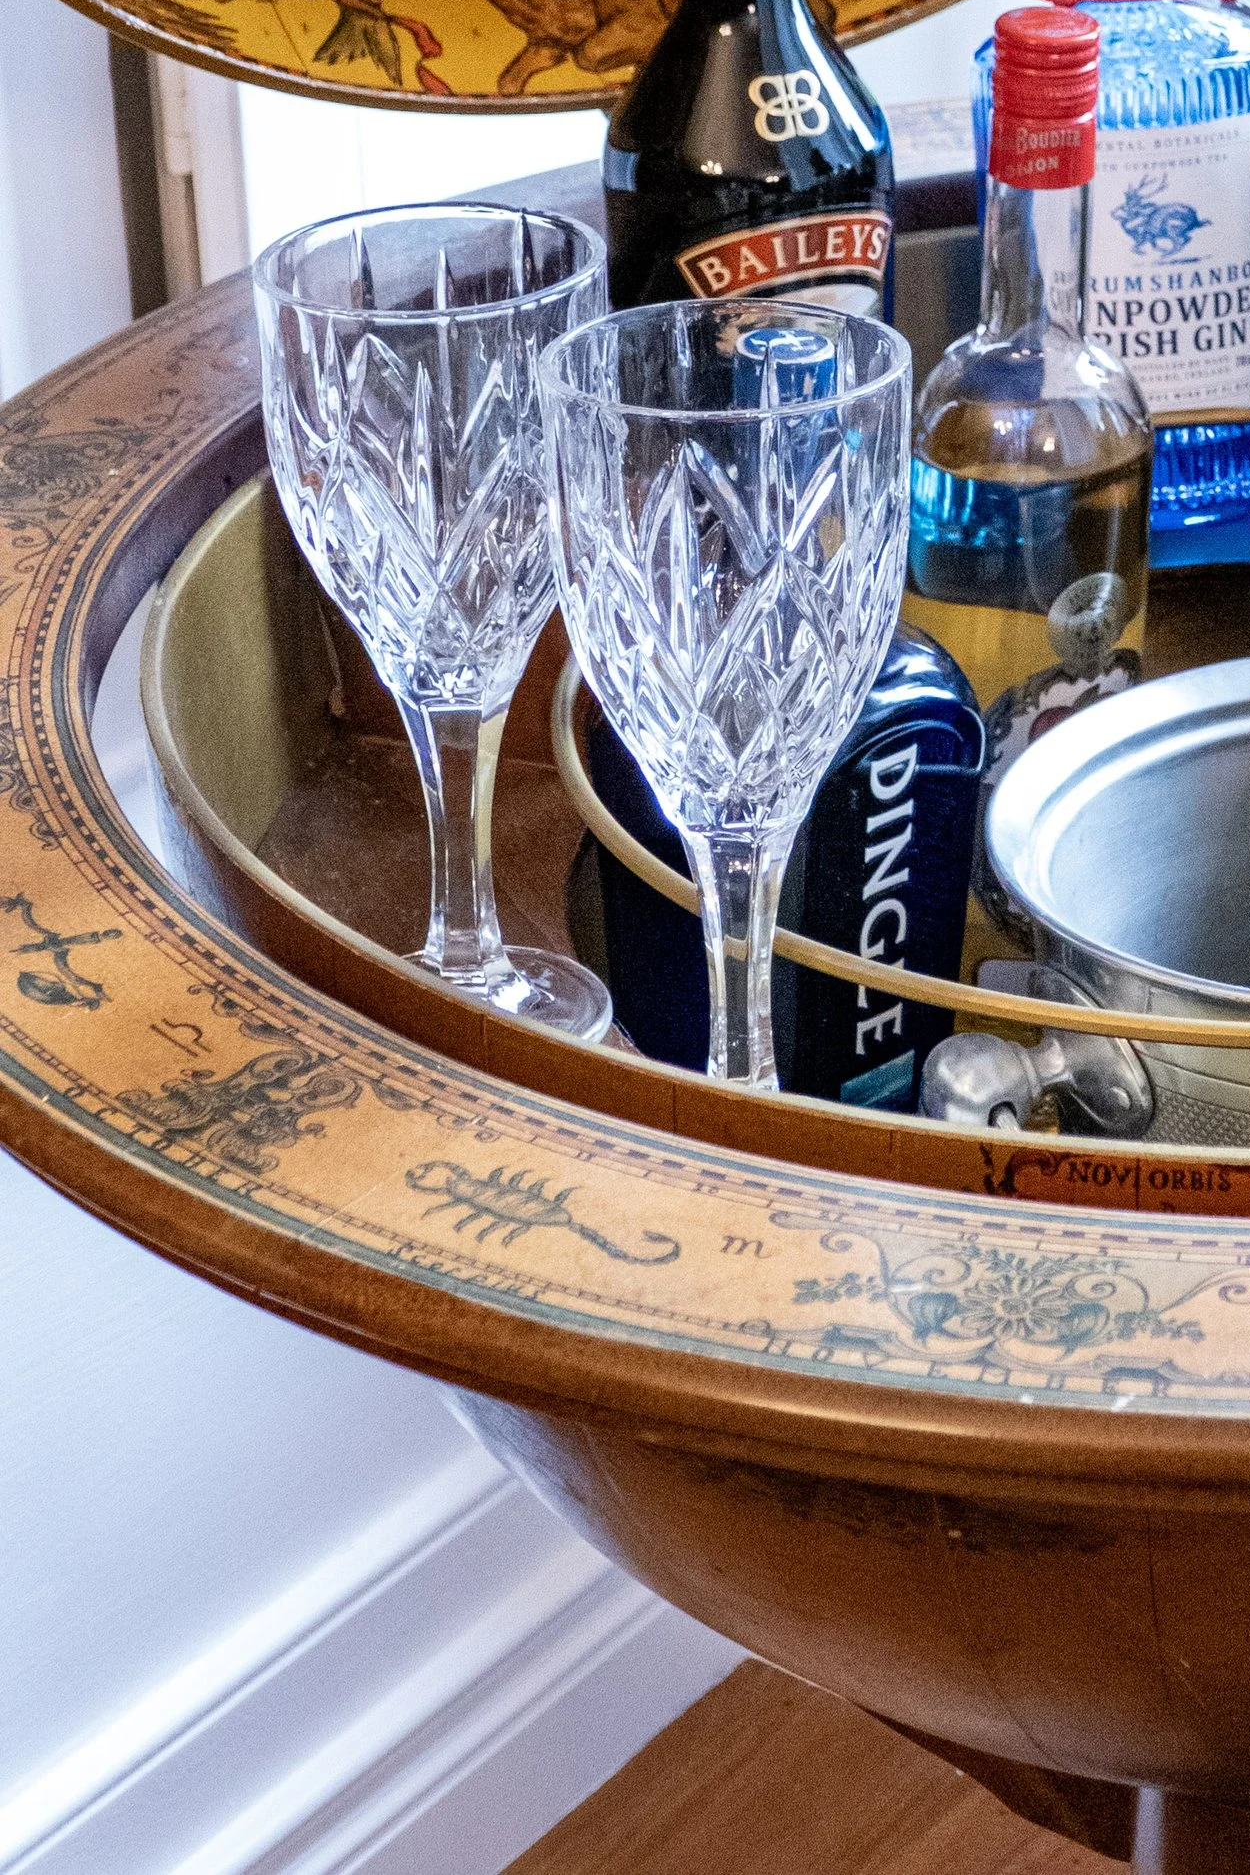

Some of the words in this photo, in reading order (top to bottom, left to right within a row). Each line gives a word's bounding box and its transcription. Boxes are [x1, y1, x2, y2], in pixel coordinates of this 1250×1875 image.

[697, 224, 886, 293] BAILEYS
[1193, 317, 1248, 353] GIN
[1149, 1168, 1232, 1193] ORBIS
